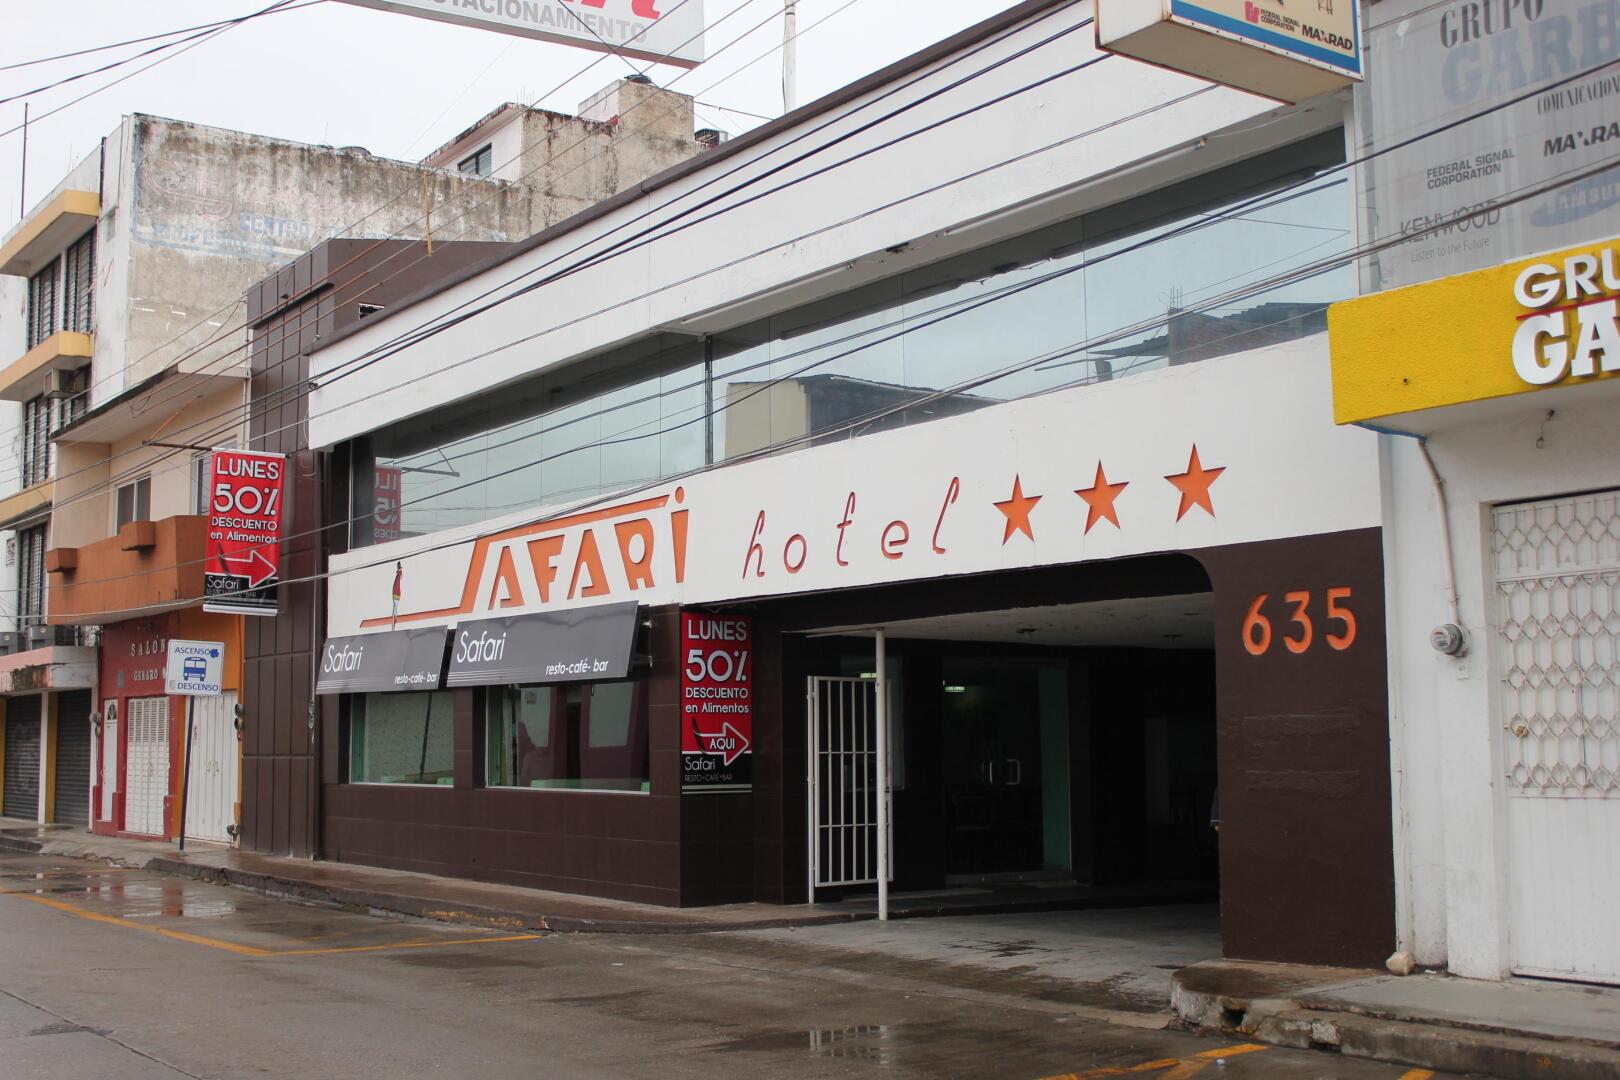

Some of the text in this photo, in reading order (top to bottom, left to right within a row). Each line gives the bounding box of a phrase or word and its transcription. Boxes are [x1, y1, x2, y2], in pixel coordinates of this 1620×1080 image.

[1260, 8, 1300, 28] FEDERAL SIGNAL
[1260, 15, 1295, 32] CORPORATION
[1427, 148, 1515, 179] FEDERAL SIGNAL
[1427, 163, 1502, 190] CORPORATION
[1400, 200, 1500, 244] KENWOOD
[1463, 238, 1490, 251] Future
[1512, 299, 1620, 385] GA
[216, 456, 279, 480] LUNES
[213, 483, 279, 516] 50%
[211, 516, 278, 531] DESCUENTO
[743, 476, 960, 580] hotel
[210, 530, 277, 544] en Alimentos
[207, 575, 240, 589] Safari
[688, 619, 747, 641] LUNES
[1242, 586, 1356, 656] 635
[174, 646, 211, 655] ASCENSO
[456, 630, 507, 664] Safari
[324, 644, 364, 673] Safari
[593, 659, 609, 673] bar
[685, 648, 748, 682] 50%
[177, 682, 219, 691] DESCENSO
[685, 687, 749, 699] DESCUENTO
[685, 702, 749, 713] en Alimentos
[709, 738, 735, 750] AQUI
[684, 756, 716, 771] Safari
